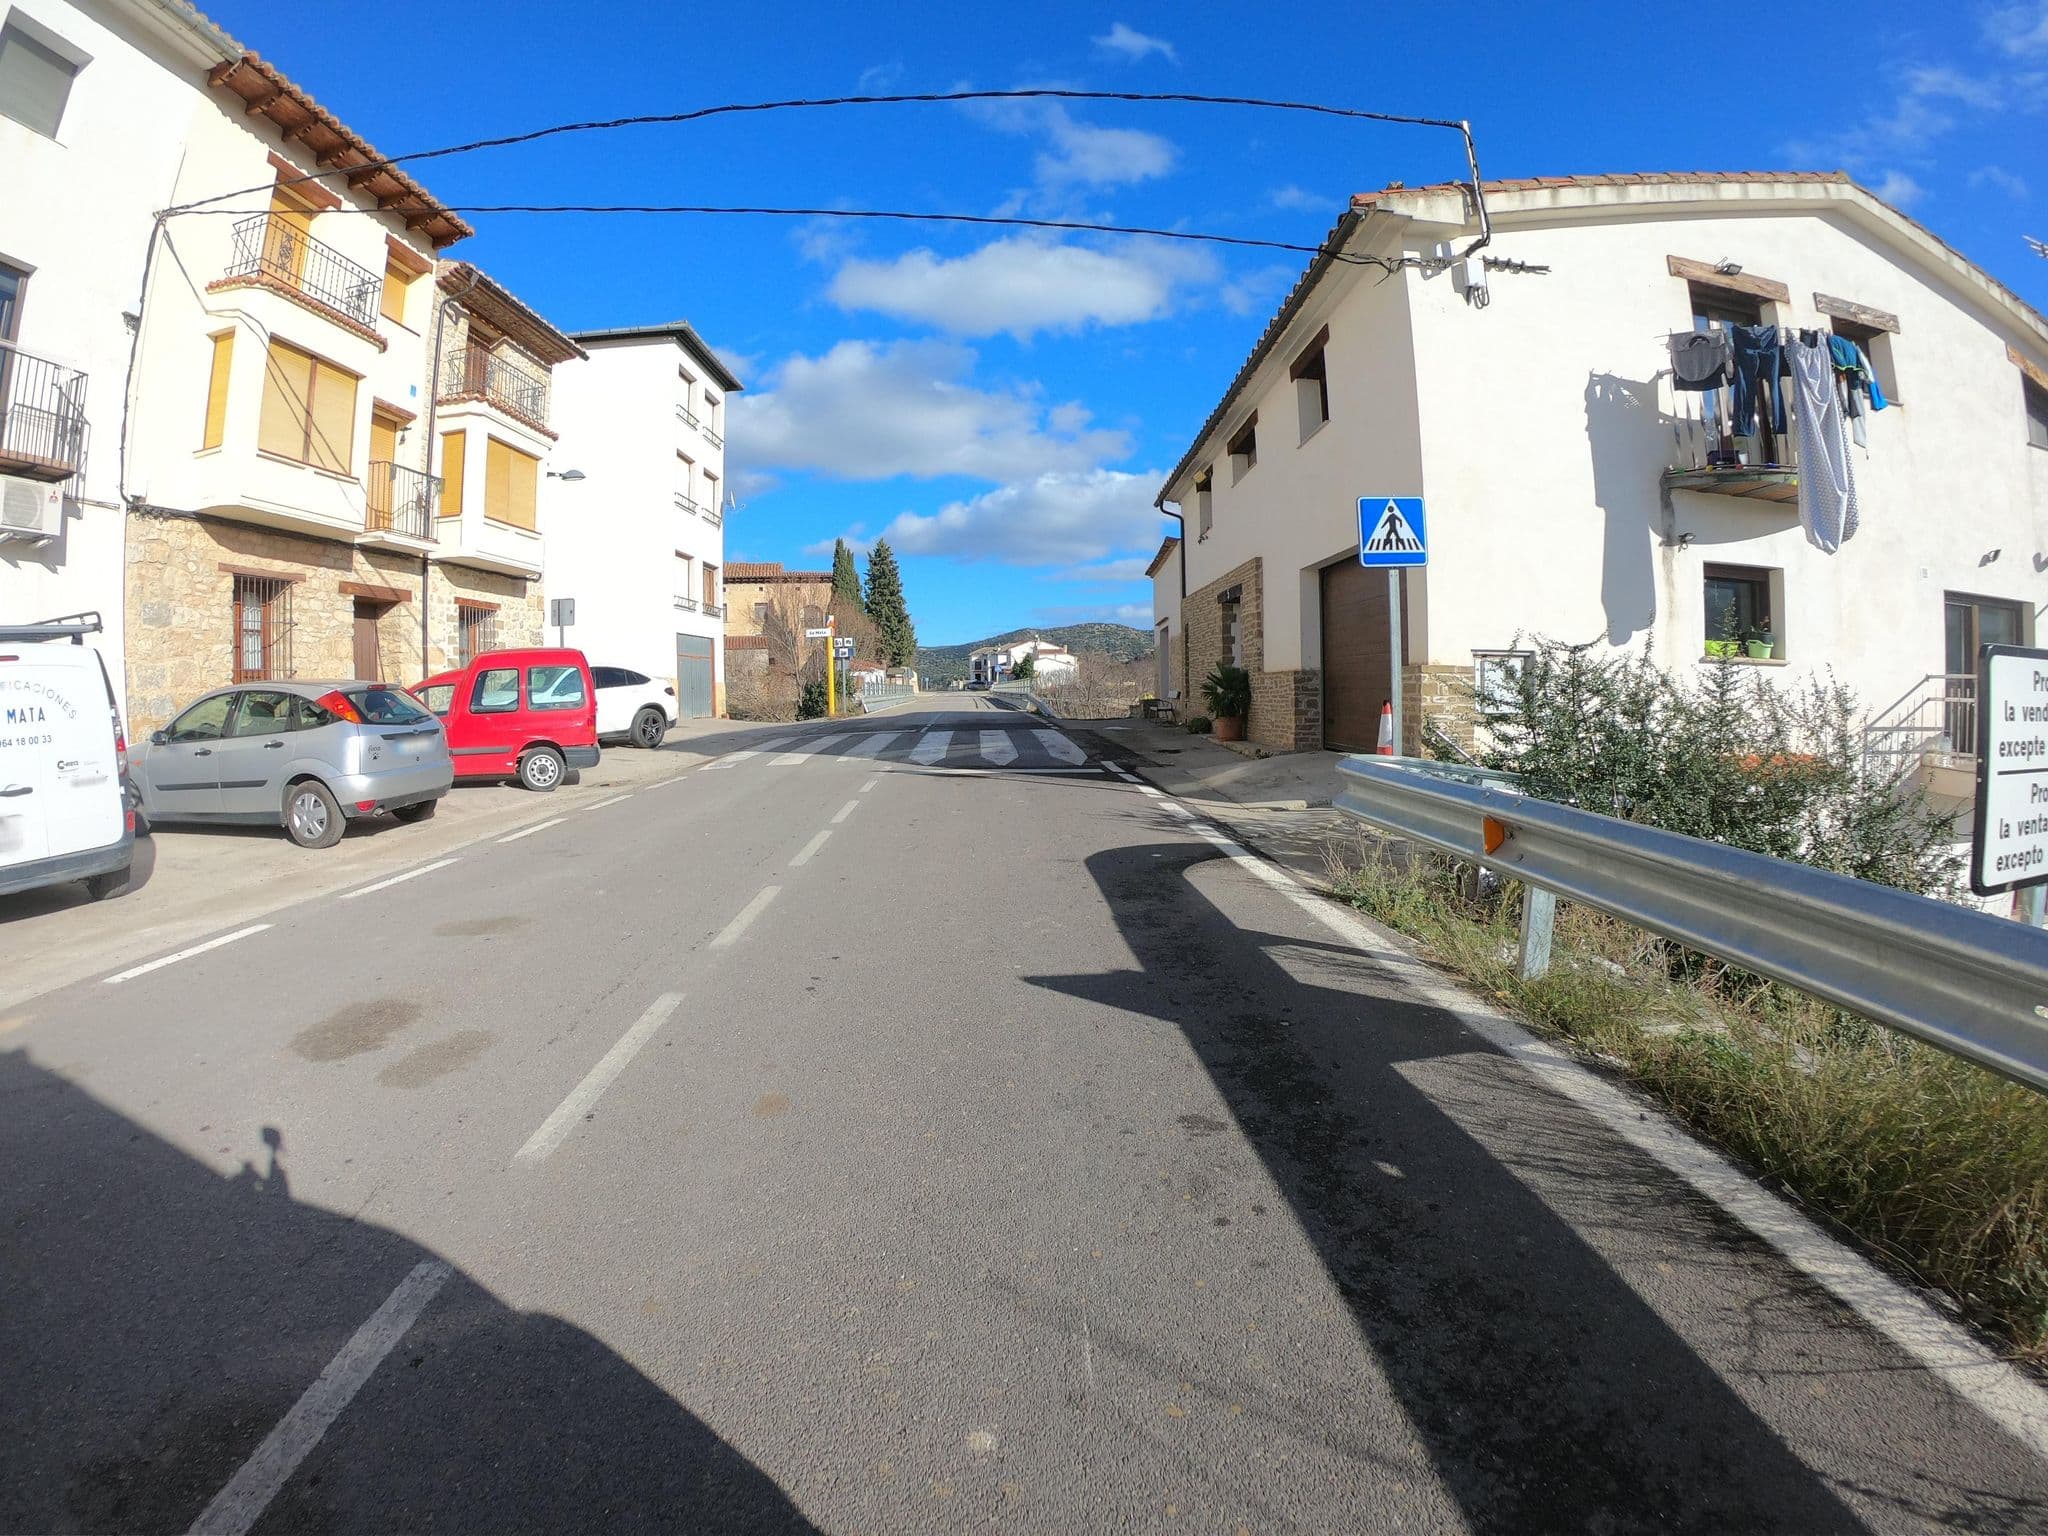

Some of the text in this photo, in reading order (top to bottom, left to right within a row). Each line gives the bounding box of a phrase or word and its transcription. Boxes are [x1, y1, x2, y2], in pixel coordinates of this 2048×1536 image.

[7, 706, 46, 724] MATA
[2004, 700, 2015, 722] la
[15, 737, 26, 746] 18
[28, 735, 39, 745] 00
[41, 734, 53, 744] 33
[1999, 736, 2045, 761] excepte
[1999, 813, 2048, 839] la venta
[1996, 845, 2043, 872] excepto
